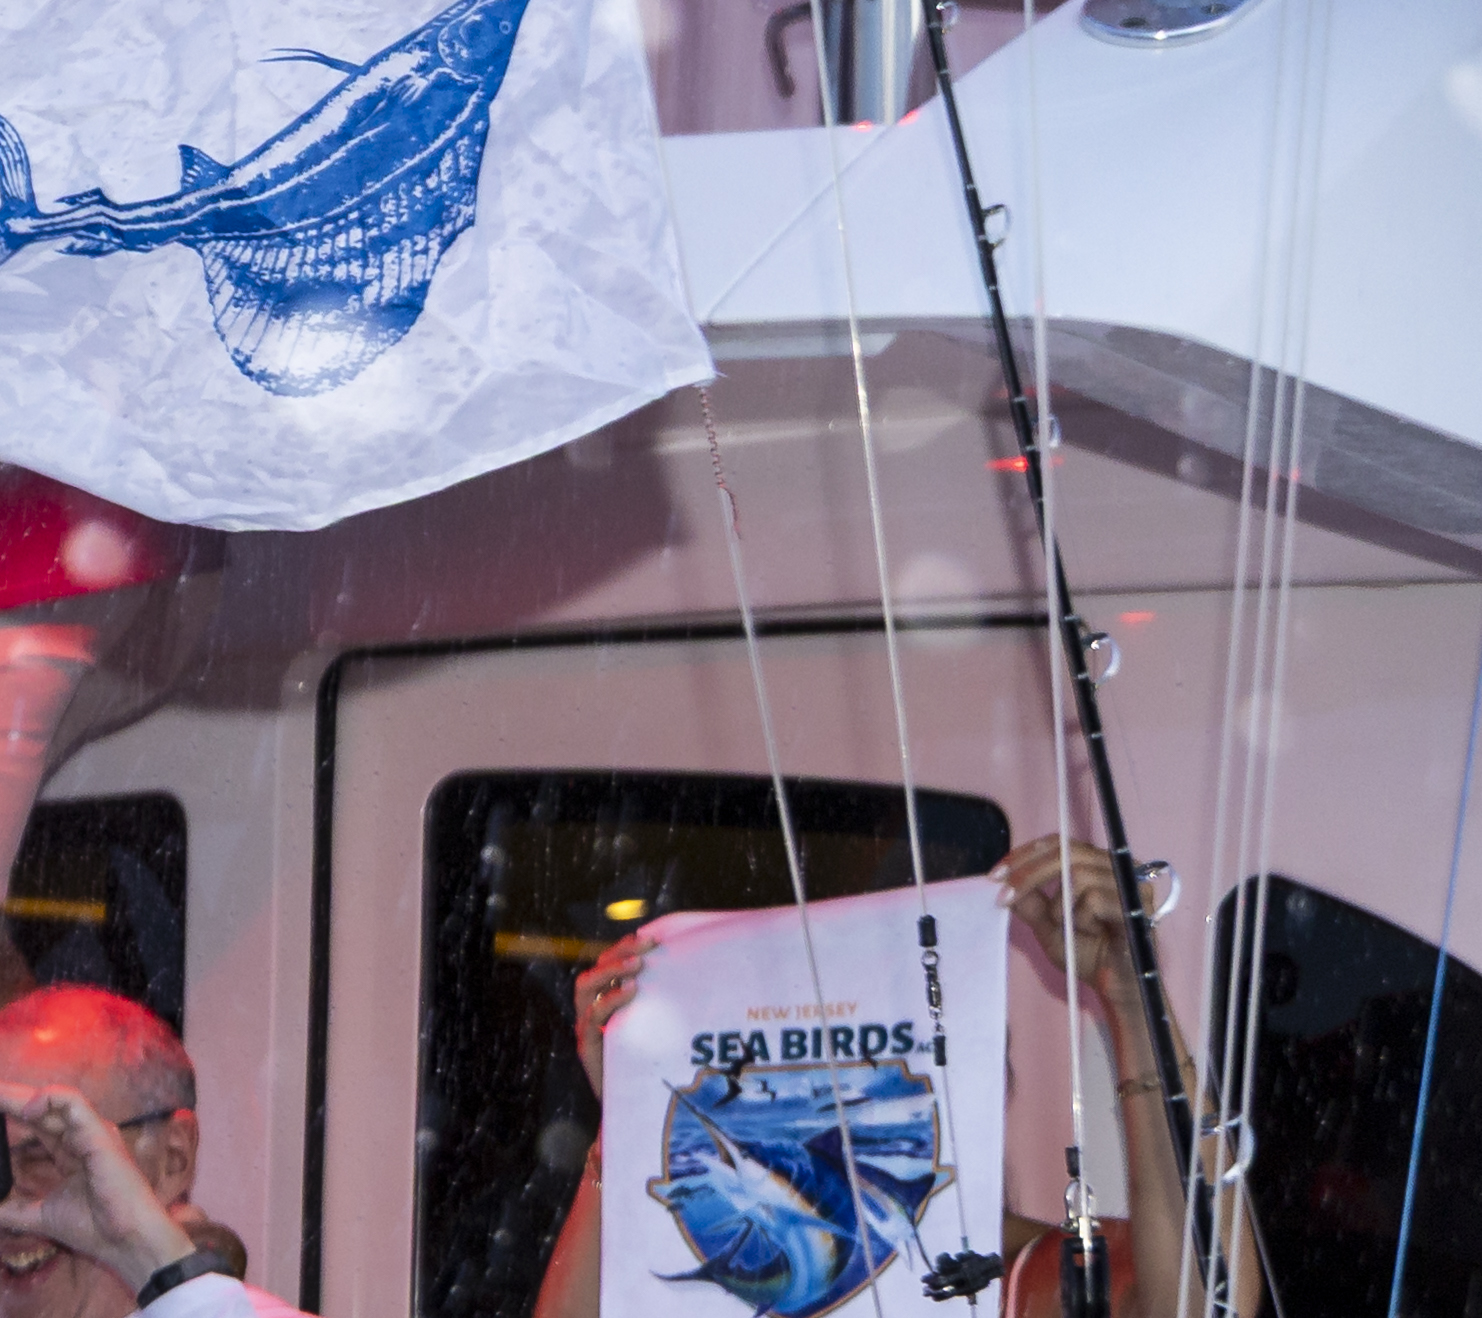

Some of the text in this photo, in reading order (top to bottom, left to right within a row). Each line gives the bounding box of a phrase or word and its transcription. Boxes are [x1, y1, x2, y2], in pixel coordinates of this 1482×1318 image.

[747, 1001, 857, 1021] NEW JERSEY
[691, 1029, 770, 1065] SEA
[781, 1021, 914, 1059] BIRDS
